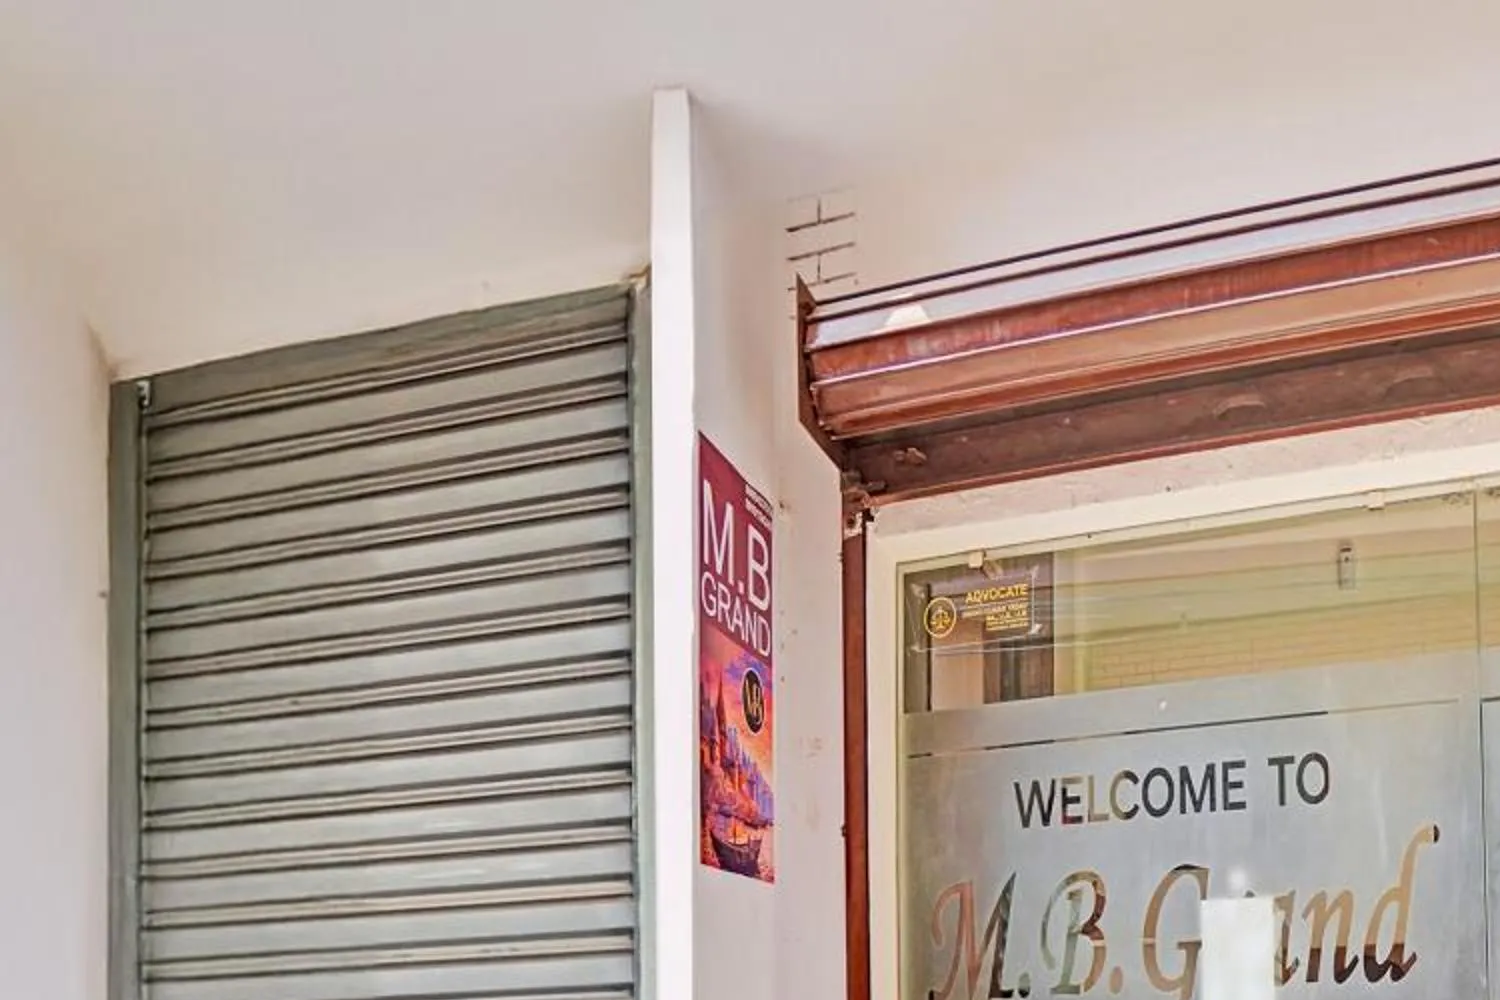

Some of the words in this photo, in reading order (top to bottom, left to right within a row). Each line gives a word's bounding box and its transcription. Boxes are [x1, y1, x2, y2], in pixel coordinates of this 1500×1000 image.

[702, 479, 771, 611] M.B
[701, 570, 772, 658] GRAND
[965, 583, 1029, 603] ADVOCATE
[1013, 760, 1247, 828] WELCOME
[1267, 752, 1331, 806] TO
